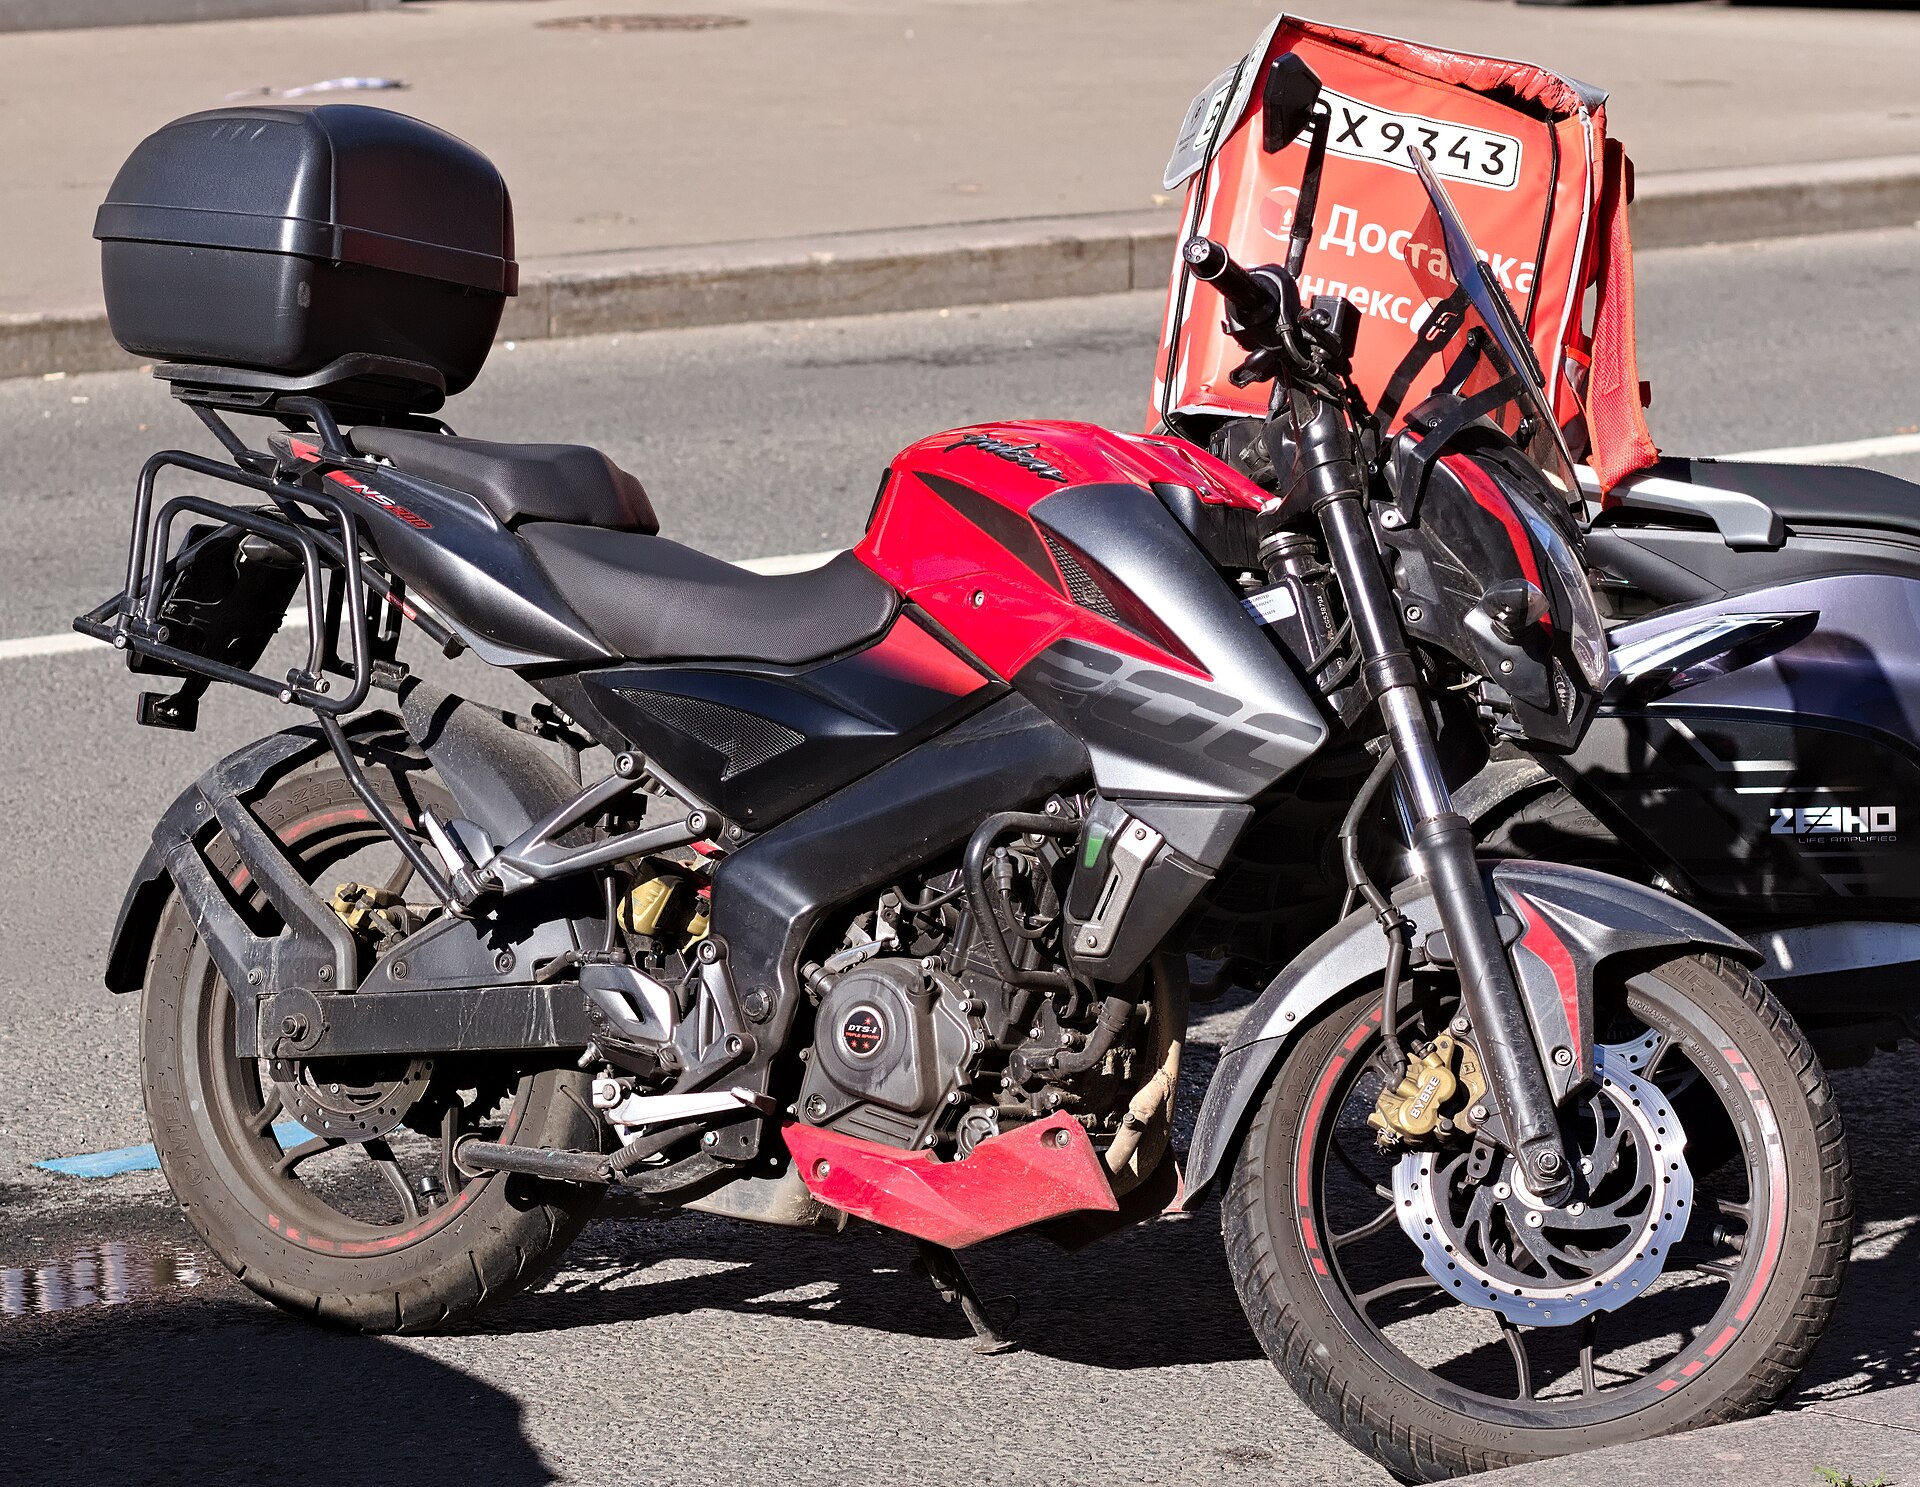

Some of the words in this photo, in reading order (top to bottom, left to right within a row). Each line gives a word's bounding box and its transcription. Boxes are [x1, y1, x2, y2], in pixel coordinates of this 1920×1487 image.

[1319, 203, 1536, 295] Достака
[1247, 264, 1412, 326] ндекс
[1798, 836, 1825, 844] LIFE
[1830, 835, 1897, 843] AMPLIFIED
[1410, 1076, 1440, 1119] BYBRE
